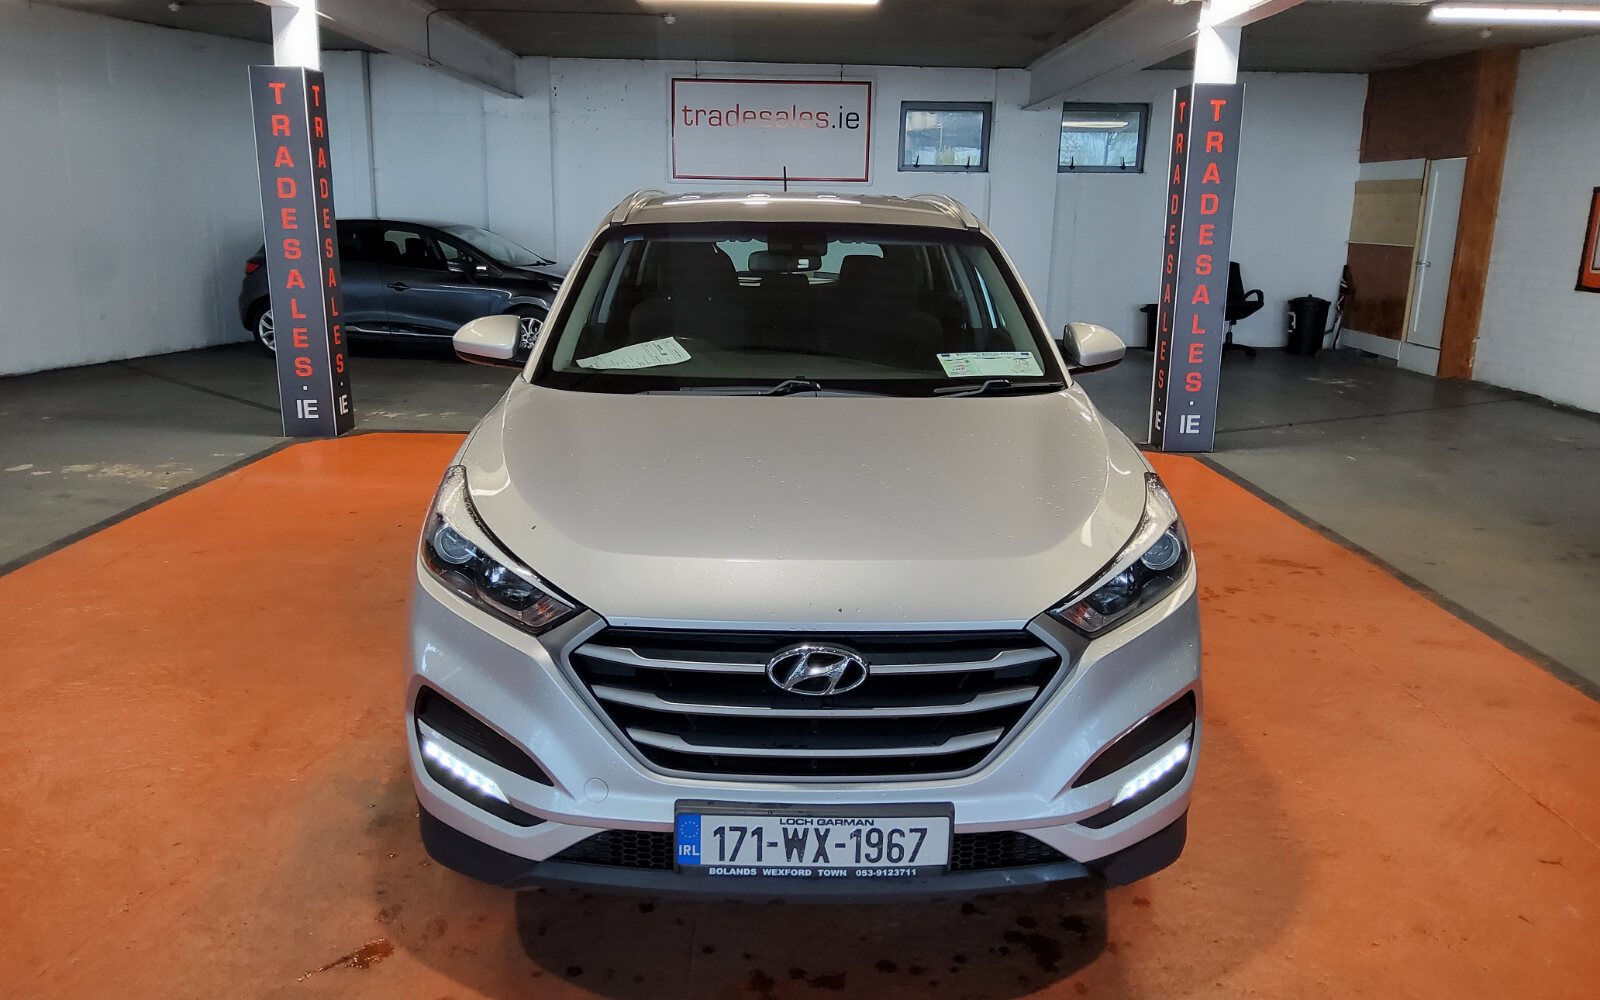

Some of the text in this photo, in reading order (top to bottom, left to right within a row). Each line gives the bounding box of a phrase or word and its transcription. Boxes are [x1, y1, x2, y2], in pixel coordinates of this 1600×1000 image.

[681, 103, 860, 129] tradesales.ie
[779, 818, 875, 827] LOCH GARMAN
[678, 844, 700, 857] IRL
[712, 826, 929, 864] 171-WX-1967
[708, 867, 917, 877] BOLANDS WEXFORD TOWN 053-9123711
